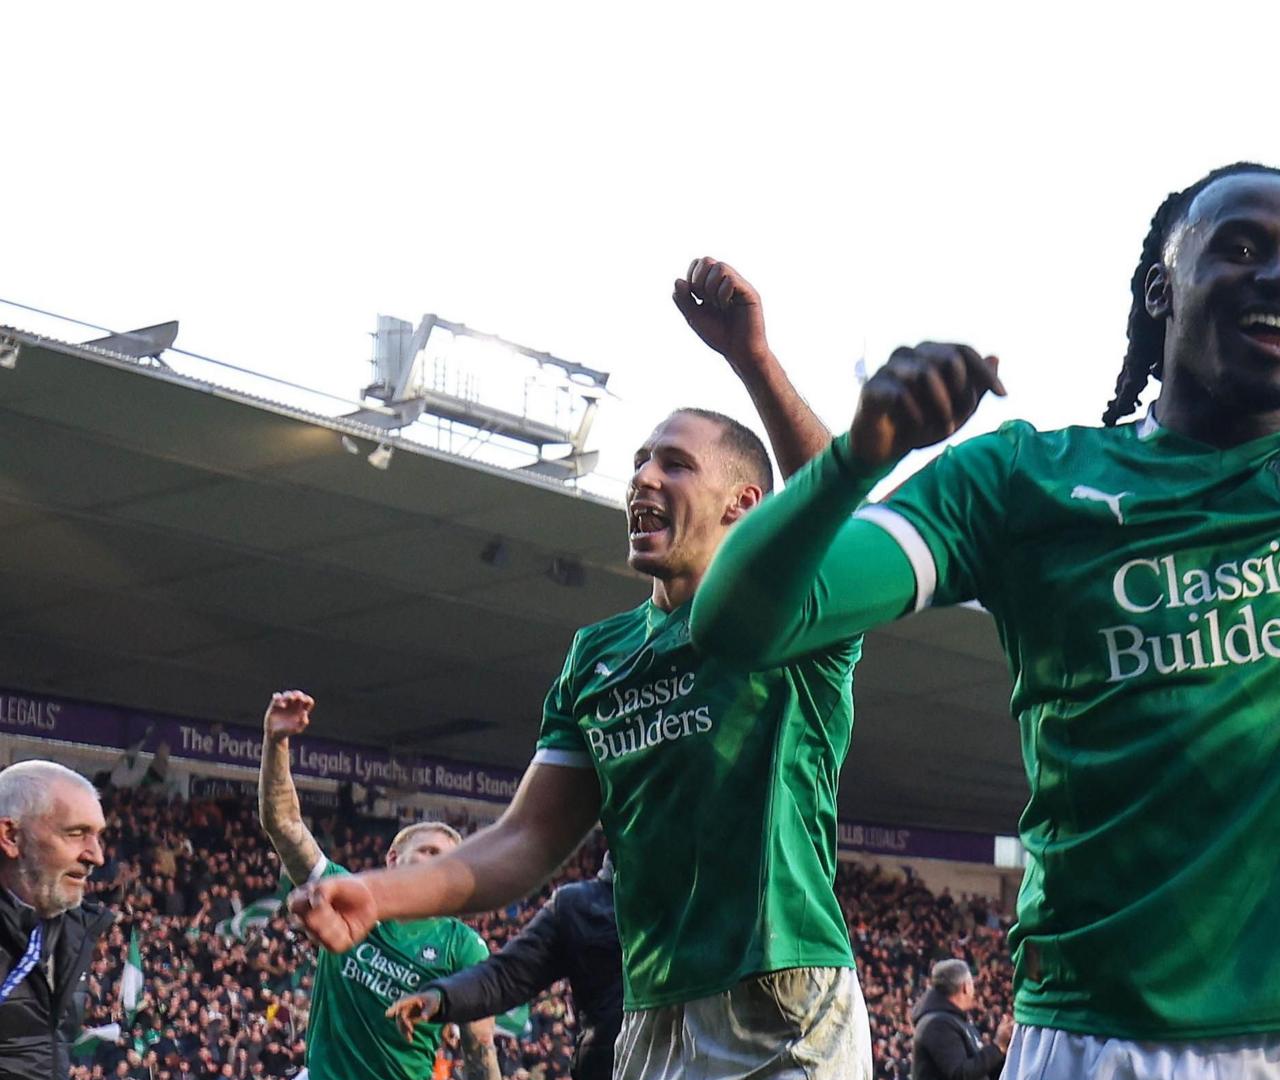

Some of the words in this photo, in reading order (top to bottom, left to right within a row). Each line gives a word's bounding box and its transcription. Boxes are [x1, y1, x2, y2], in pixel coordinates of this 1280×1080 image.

[595, 665, 696, 722] Classic
[180, 726, 213, 752] The
[300, 745, 350, 777] Legals
[435, 765, 473, 792] Road
[586, 705, 713, 763] Builders
[356, 942, 420, 987] Classic
